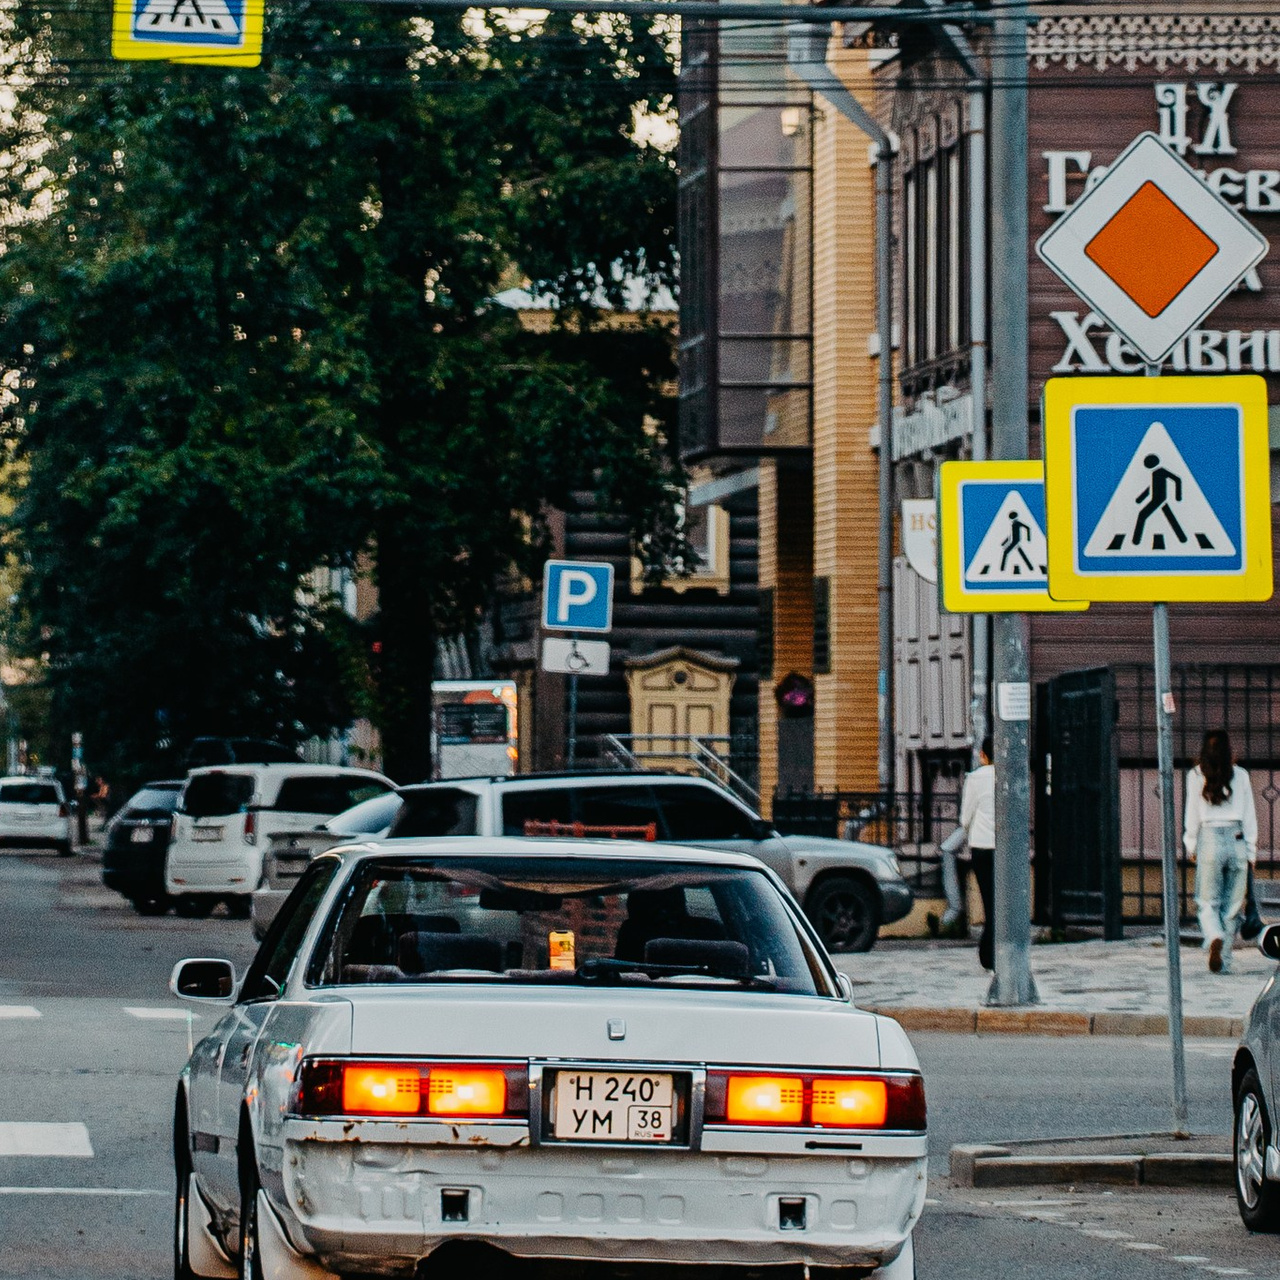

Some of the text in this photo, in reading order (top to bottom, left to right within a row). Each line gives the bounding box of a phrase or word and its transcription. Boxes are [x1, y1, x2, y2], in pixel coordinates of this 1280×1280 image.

[556, 569, 598, 623] P
[604, 1076, 655, 1102] 240
[572, 1108, 663, 1134] УМ 38
[634, 1130, 652, 1138] RUS
